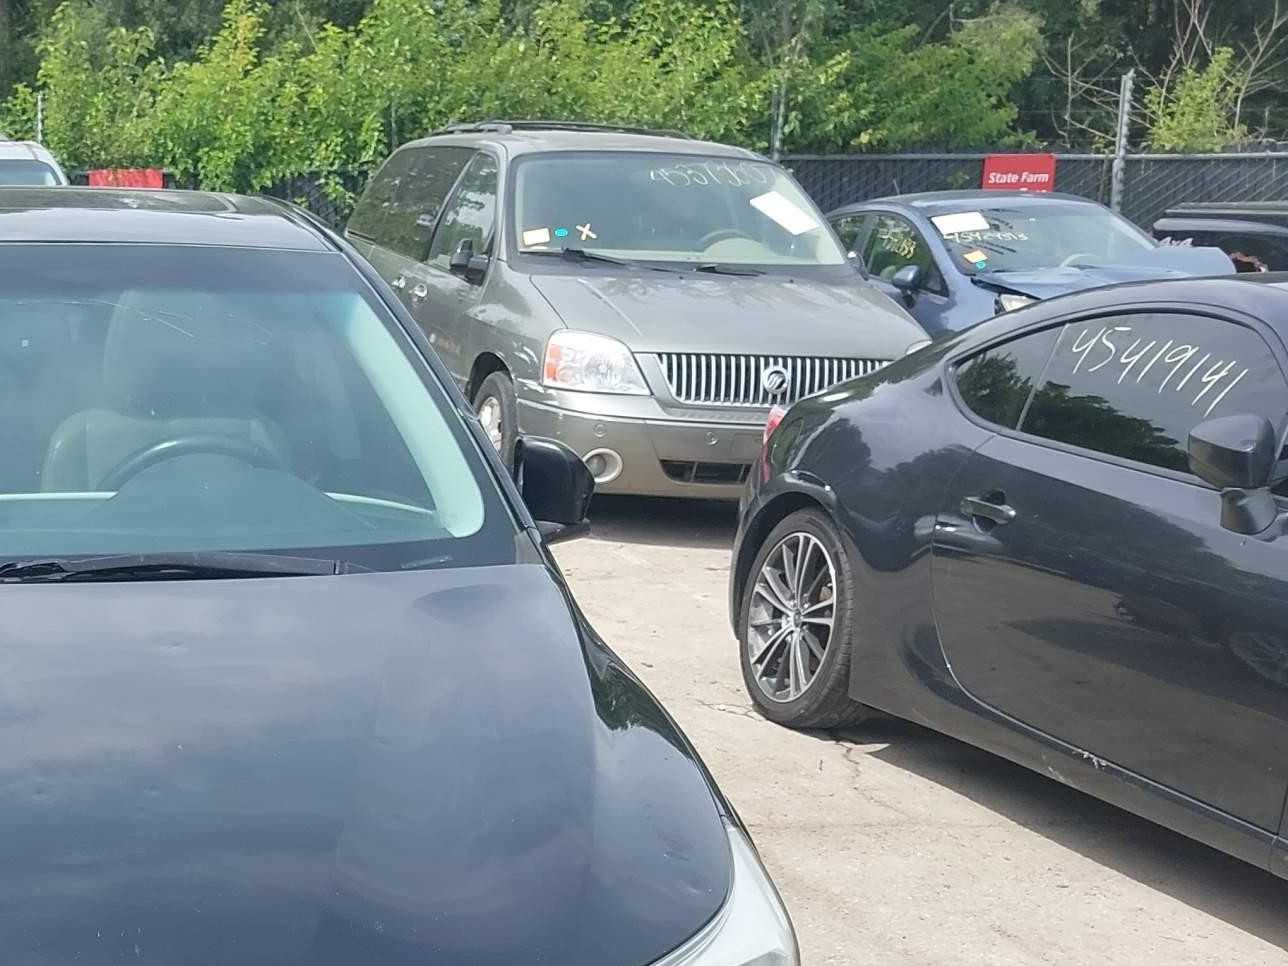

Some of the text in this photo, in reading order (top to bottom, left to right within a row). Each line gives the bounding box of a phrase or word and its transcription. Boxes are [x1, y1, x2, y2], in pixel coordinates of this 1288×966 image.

[988, 171, 1050, 184] State Farm
[1071, 326, 1249, 418] 45419141
